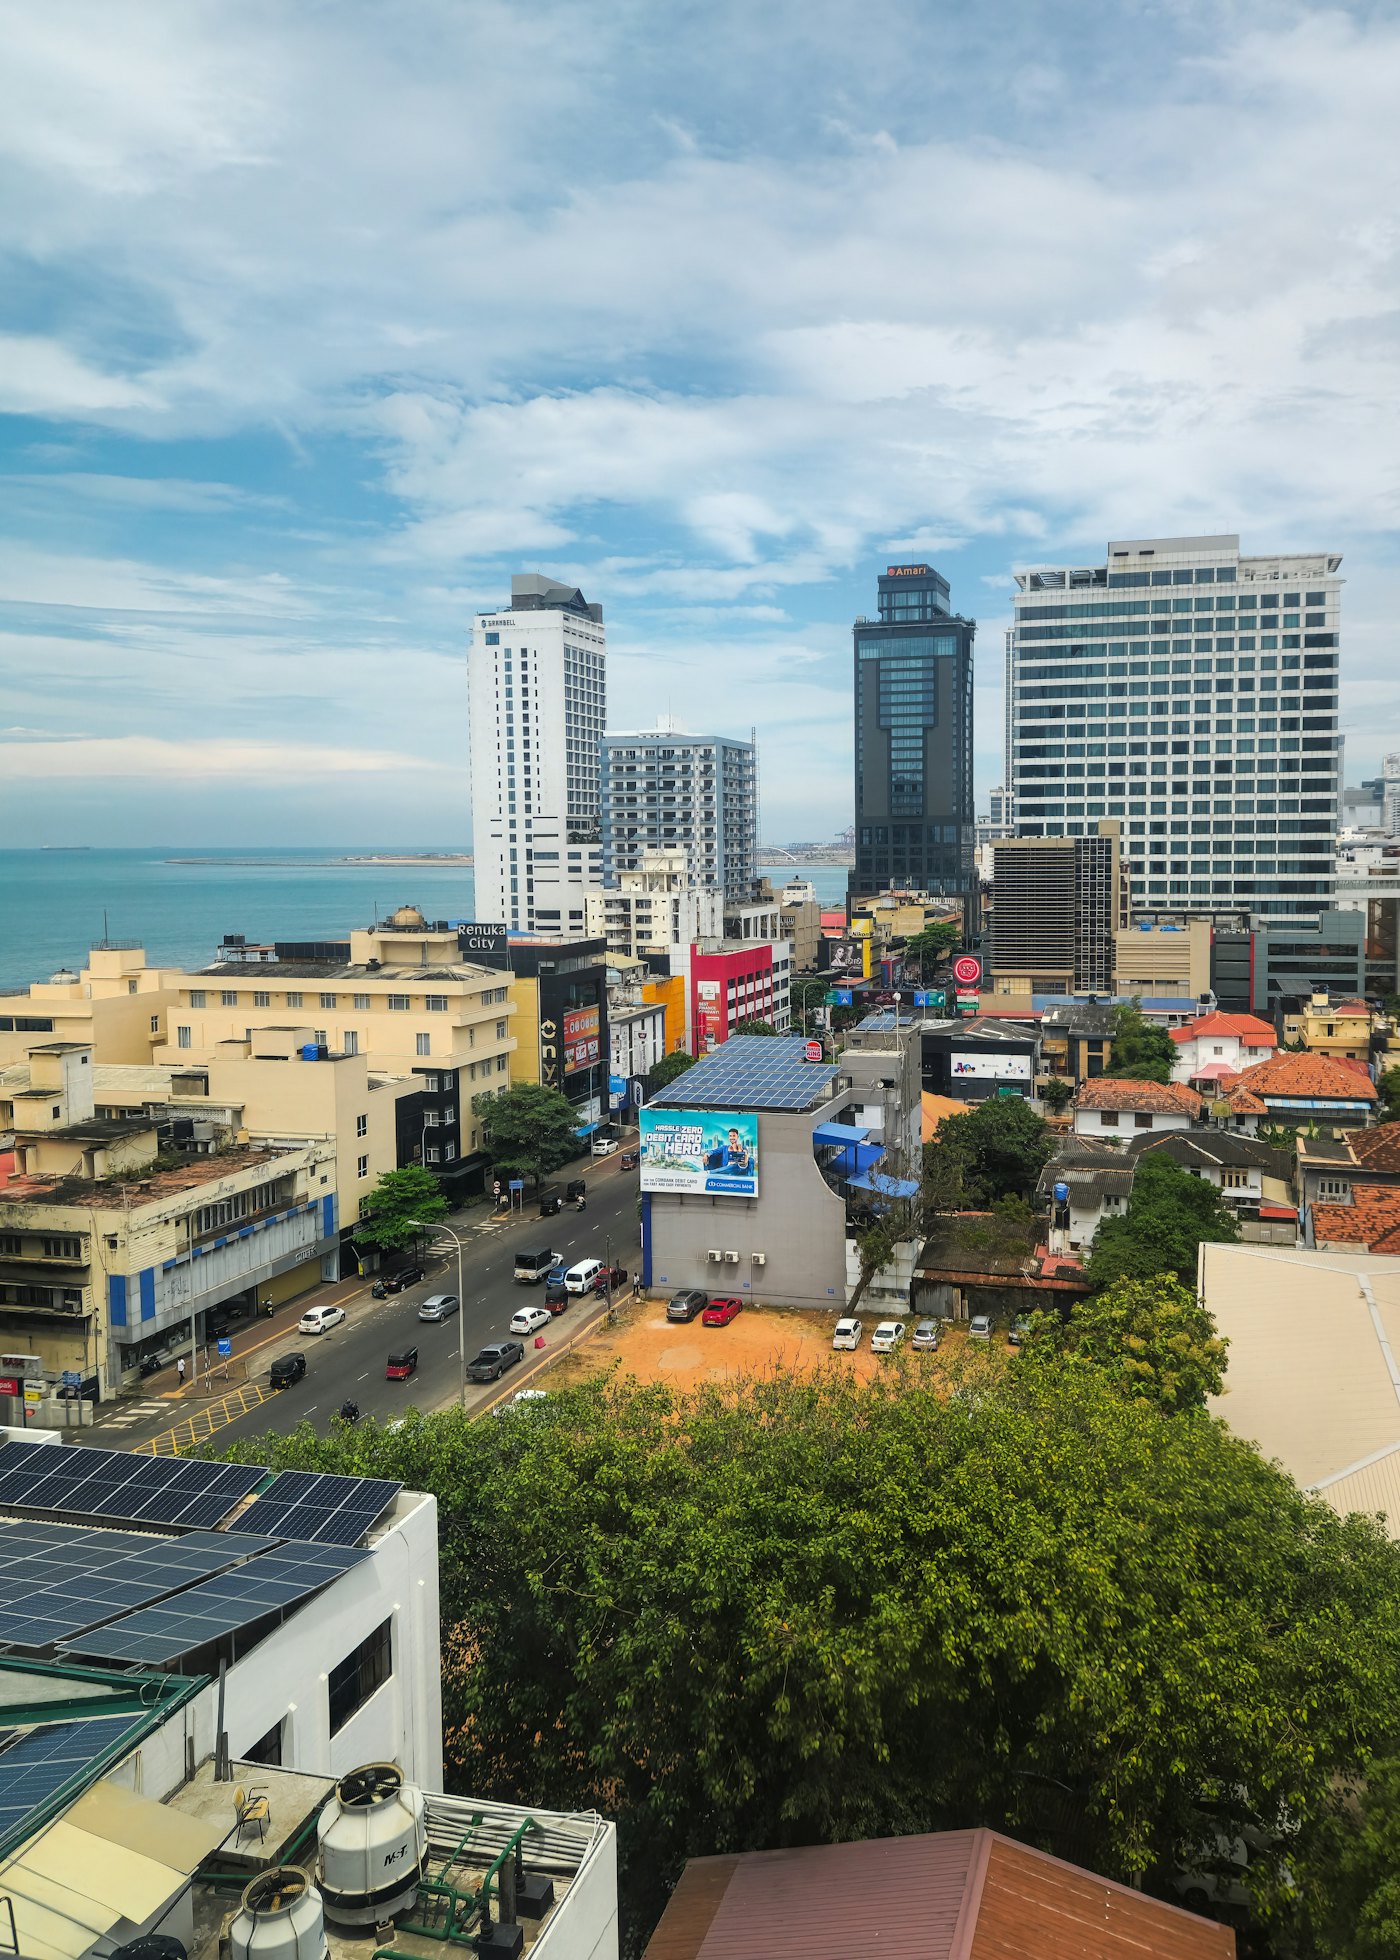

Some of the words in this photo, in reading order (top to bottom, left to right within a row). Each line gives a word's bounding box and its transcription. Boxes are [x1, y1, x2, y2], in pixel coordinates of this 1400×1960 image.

[895, 567, 926, 576] Amari
[458, 924, 506, 935] Renuka
[469, 936, 495, 950] City
[681, 1126, 703, 1134] ZERO
[646, 1133, 673, 1142] DEBIT
[674, 1134, 702, 1143] CARD
[664, 1142, 702, 1155] HERO
